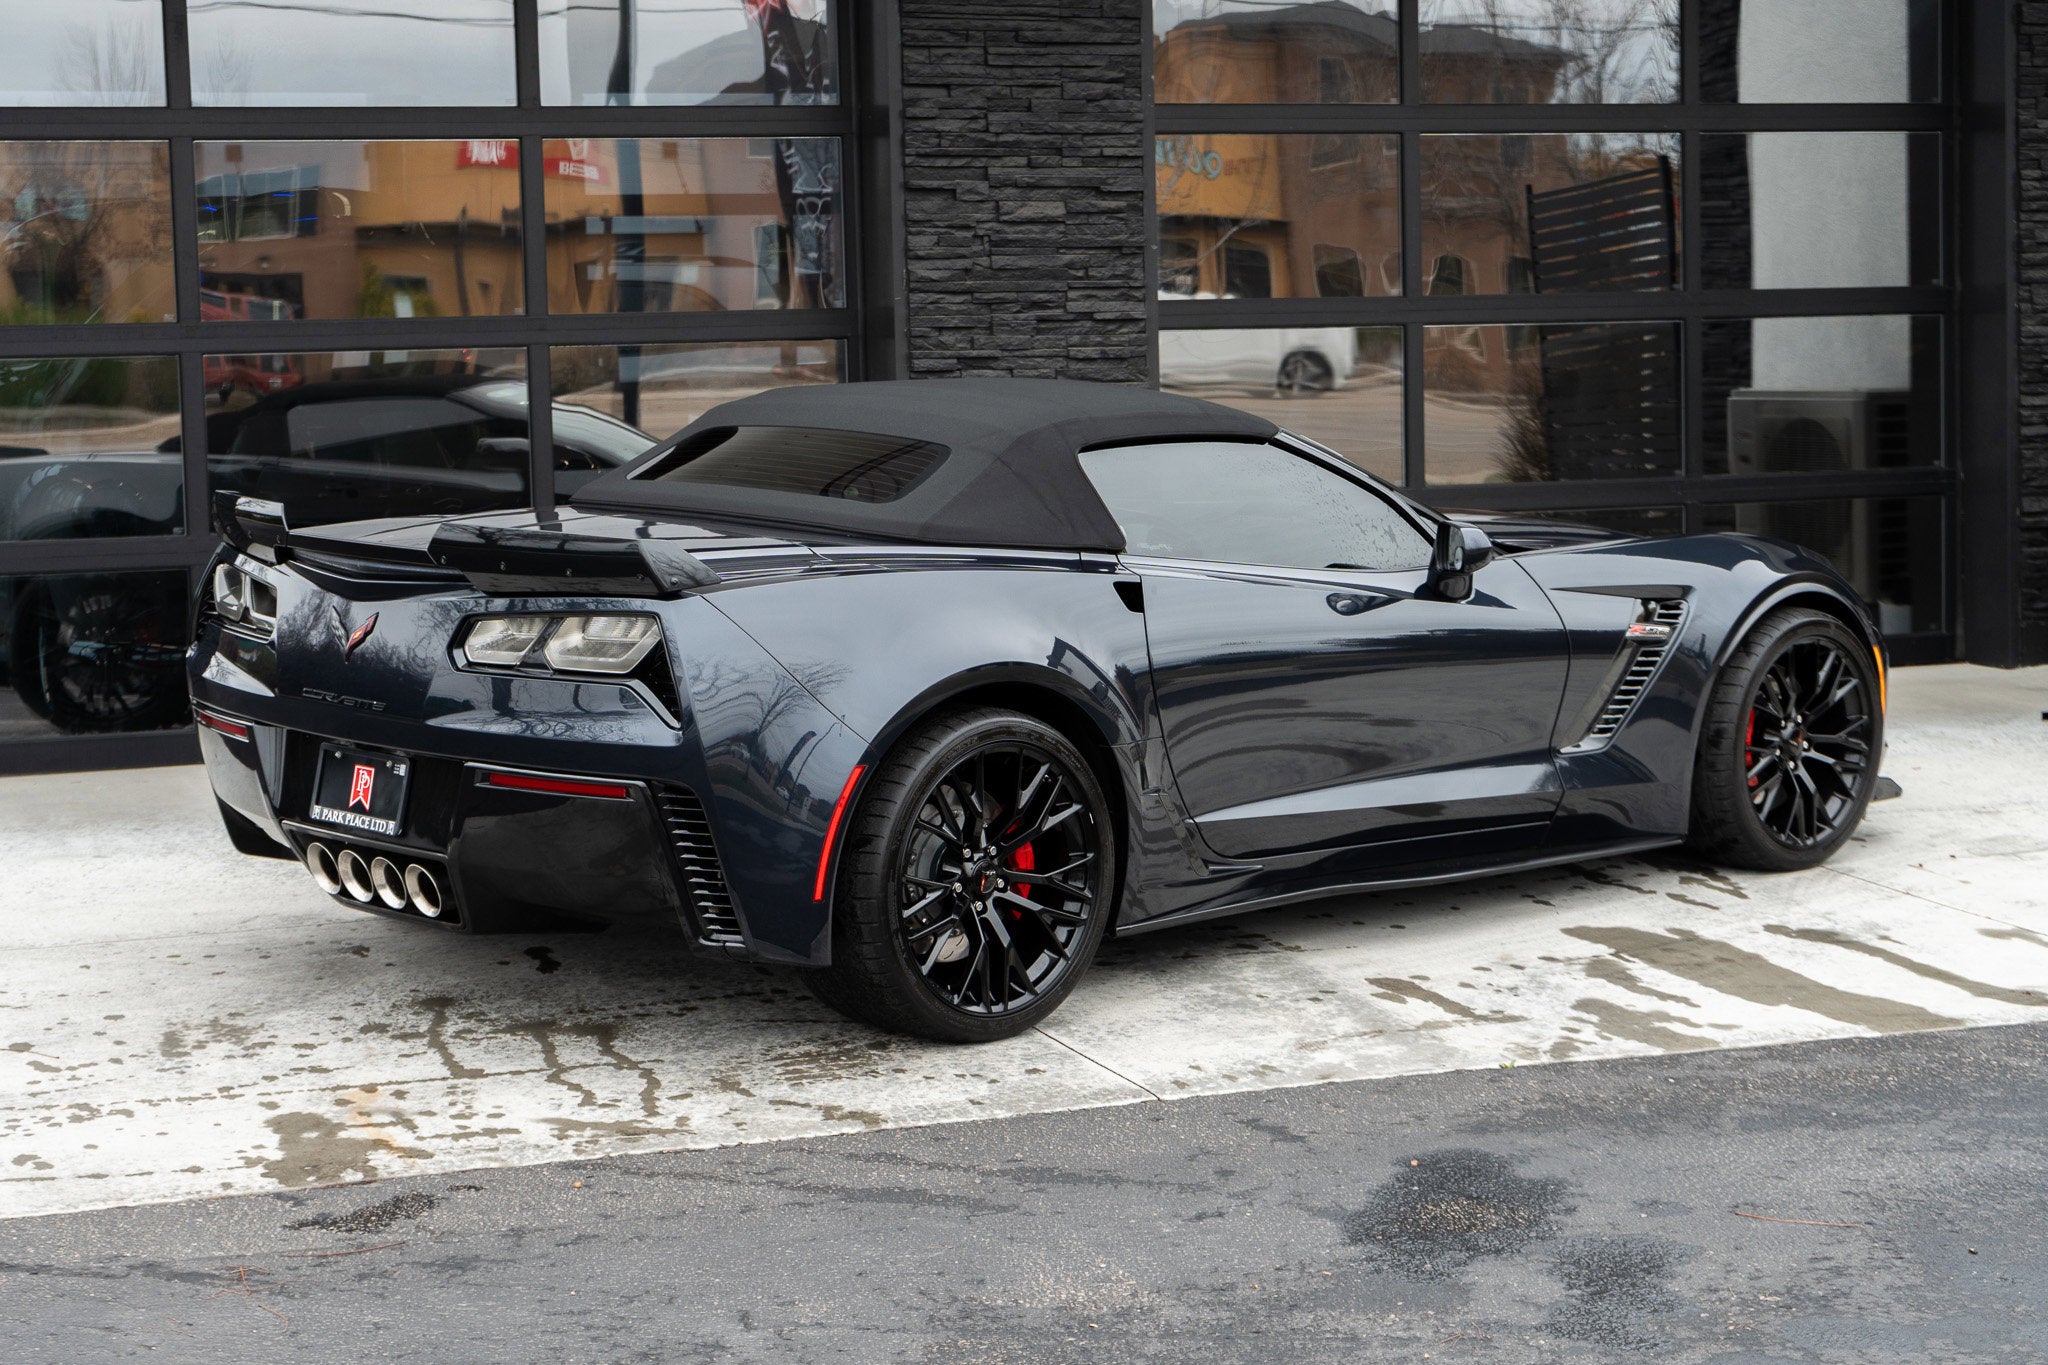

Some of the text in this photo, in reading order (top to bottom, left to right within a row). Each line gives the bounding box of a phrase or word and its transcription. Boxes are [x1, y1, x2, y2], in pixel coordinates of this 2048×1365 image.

[322, 808, 345, 823] PARK
[345, 814, 371, 829] PLACE
[370, 818, 387, 833] LTD
